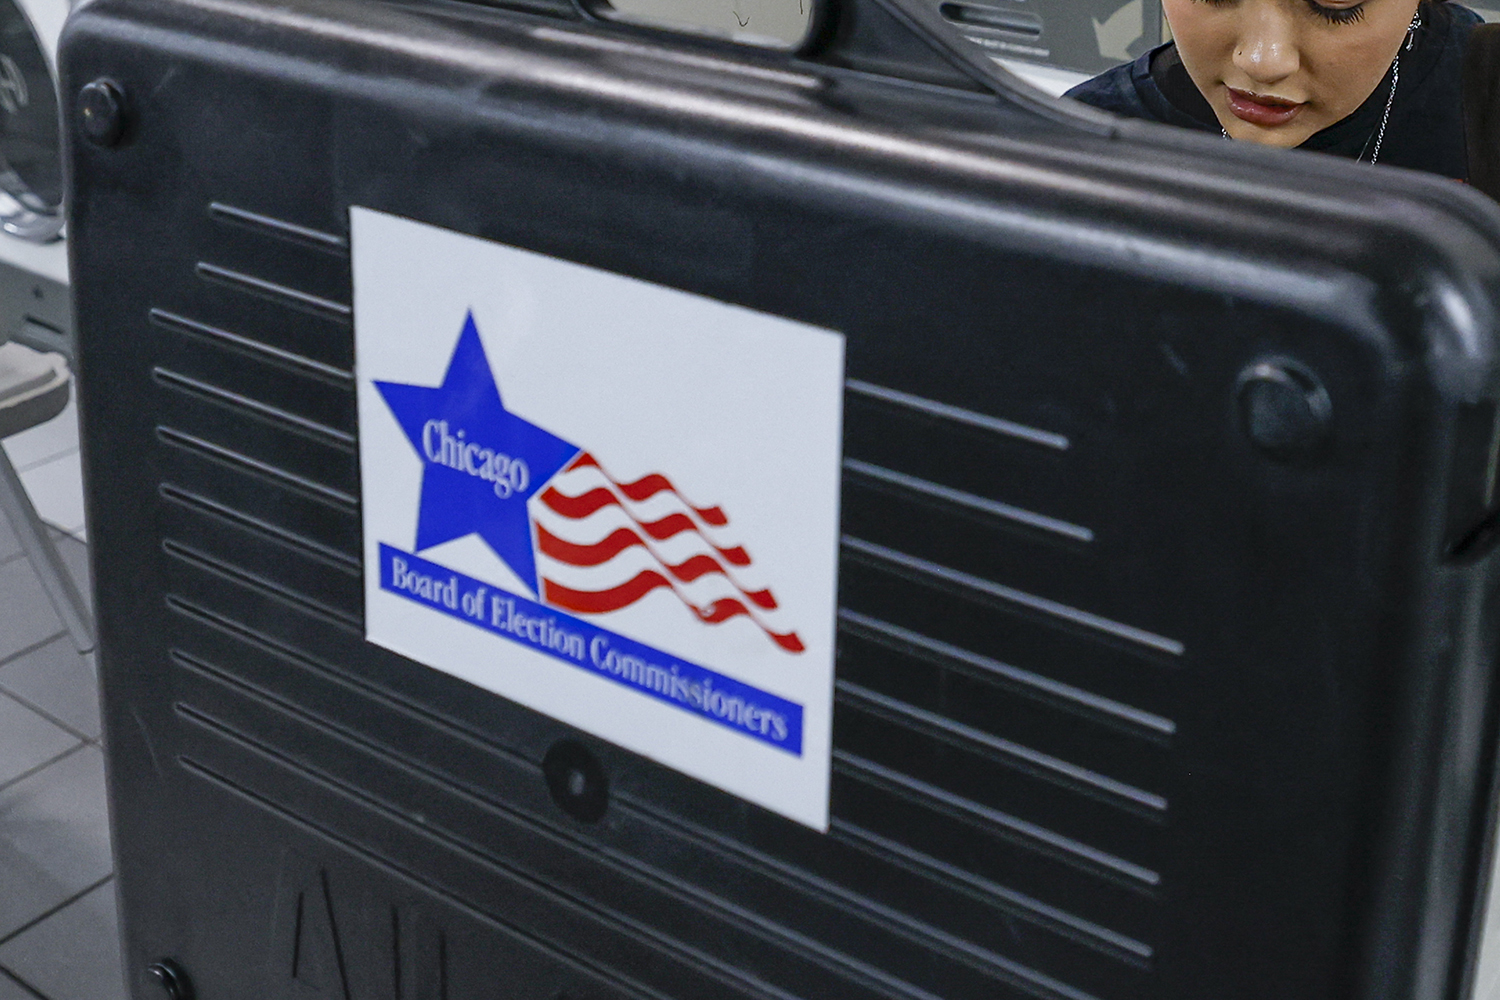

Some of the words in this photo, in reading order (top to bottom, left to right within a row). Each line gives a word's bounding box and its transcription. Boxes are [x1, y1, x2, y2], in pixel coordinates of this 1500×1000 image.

[422, 419, 530, 500] Chicago
[392, 556, 459, 614] Board
[461, 577, 487, 621] of
[490, 588, 586, 660] Election
[590, 637, 788, 742] Commissioners
